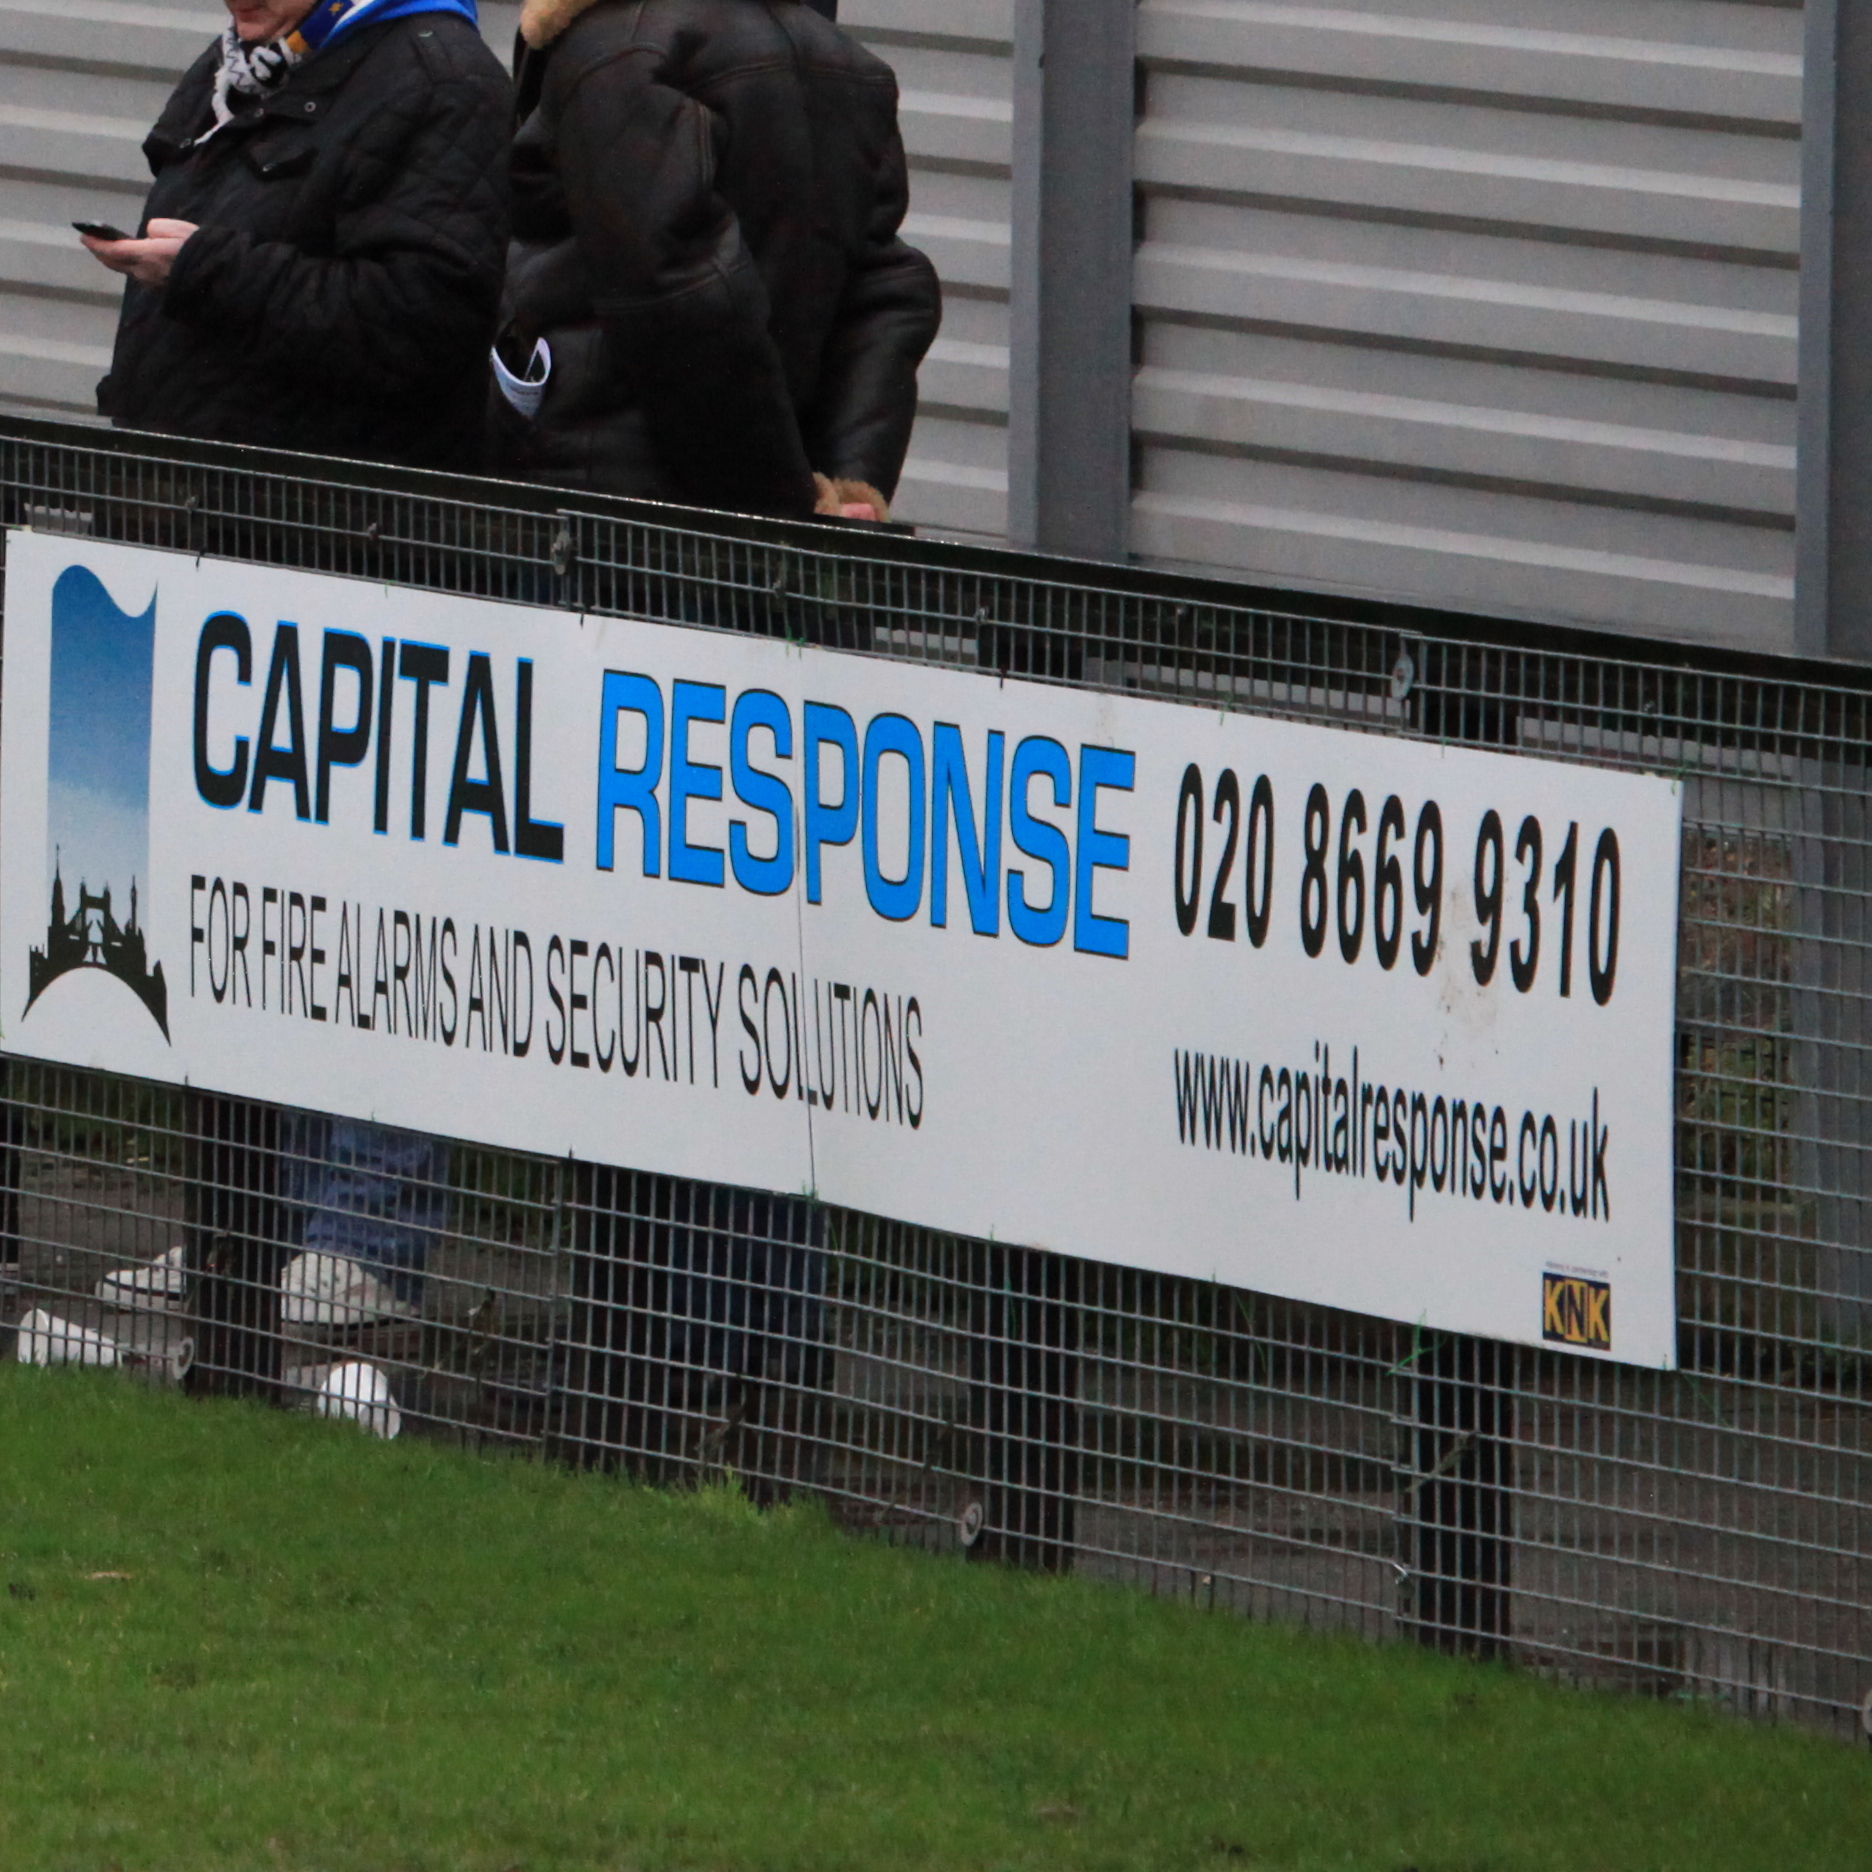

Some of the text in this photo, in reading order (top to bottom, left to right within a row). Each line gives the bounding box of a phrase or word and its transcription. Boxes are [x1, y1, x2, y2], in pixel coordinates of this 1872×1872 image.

[192, 610, 1136, 960] CAPITAL RESPONSE
[1174, 762, 1621, 1007] 020 8669 9310
[190, 874, 924, 1129] FOR FIRE ALARMS AND SECURITY SOLUTIONS
[1174, 1039, 1611, 1223] www.capitalresponse.co.uk
